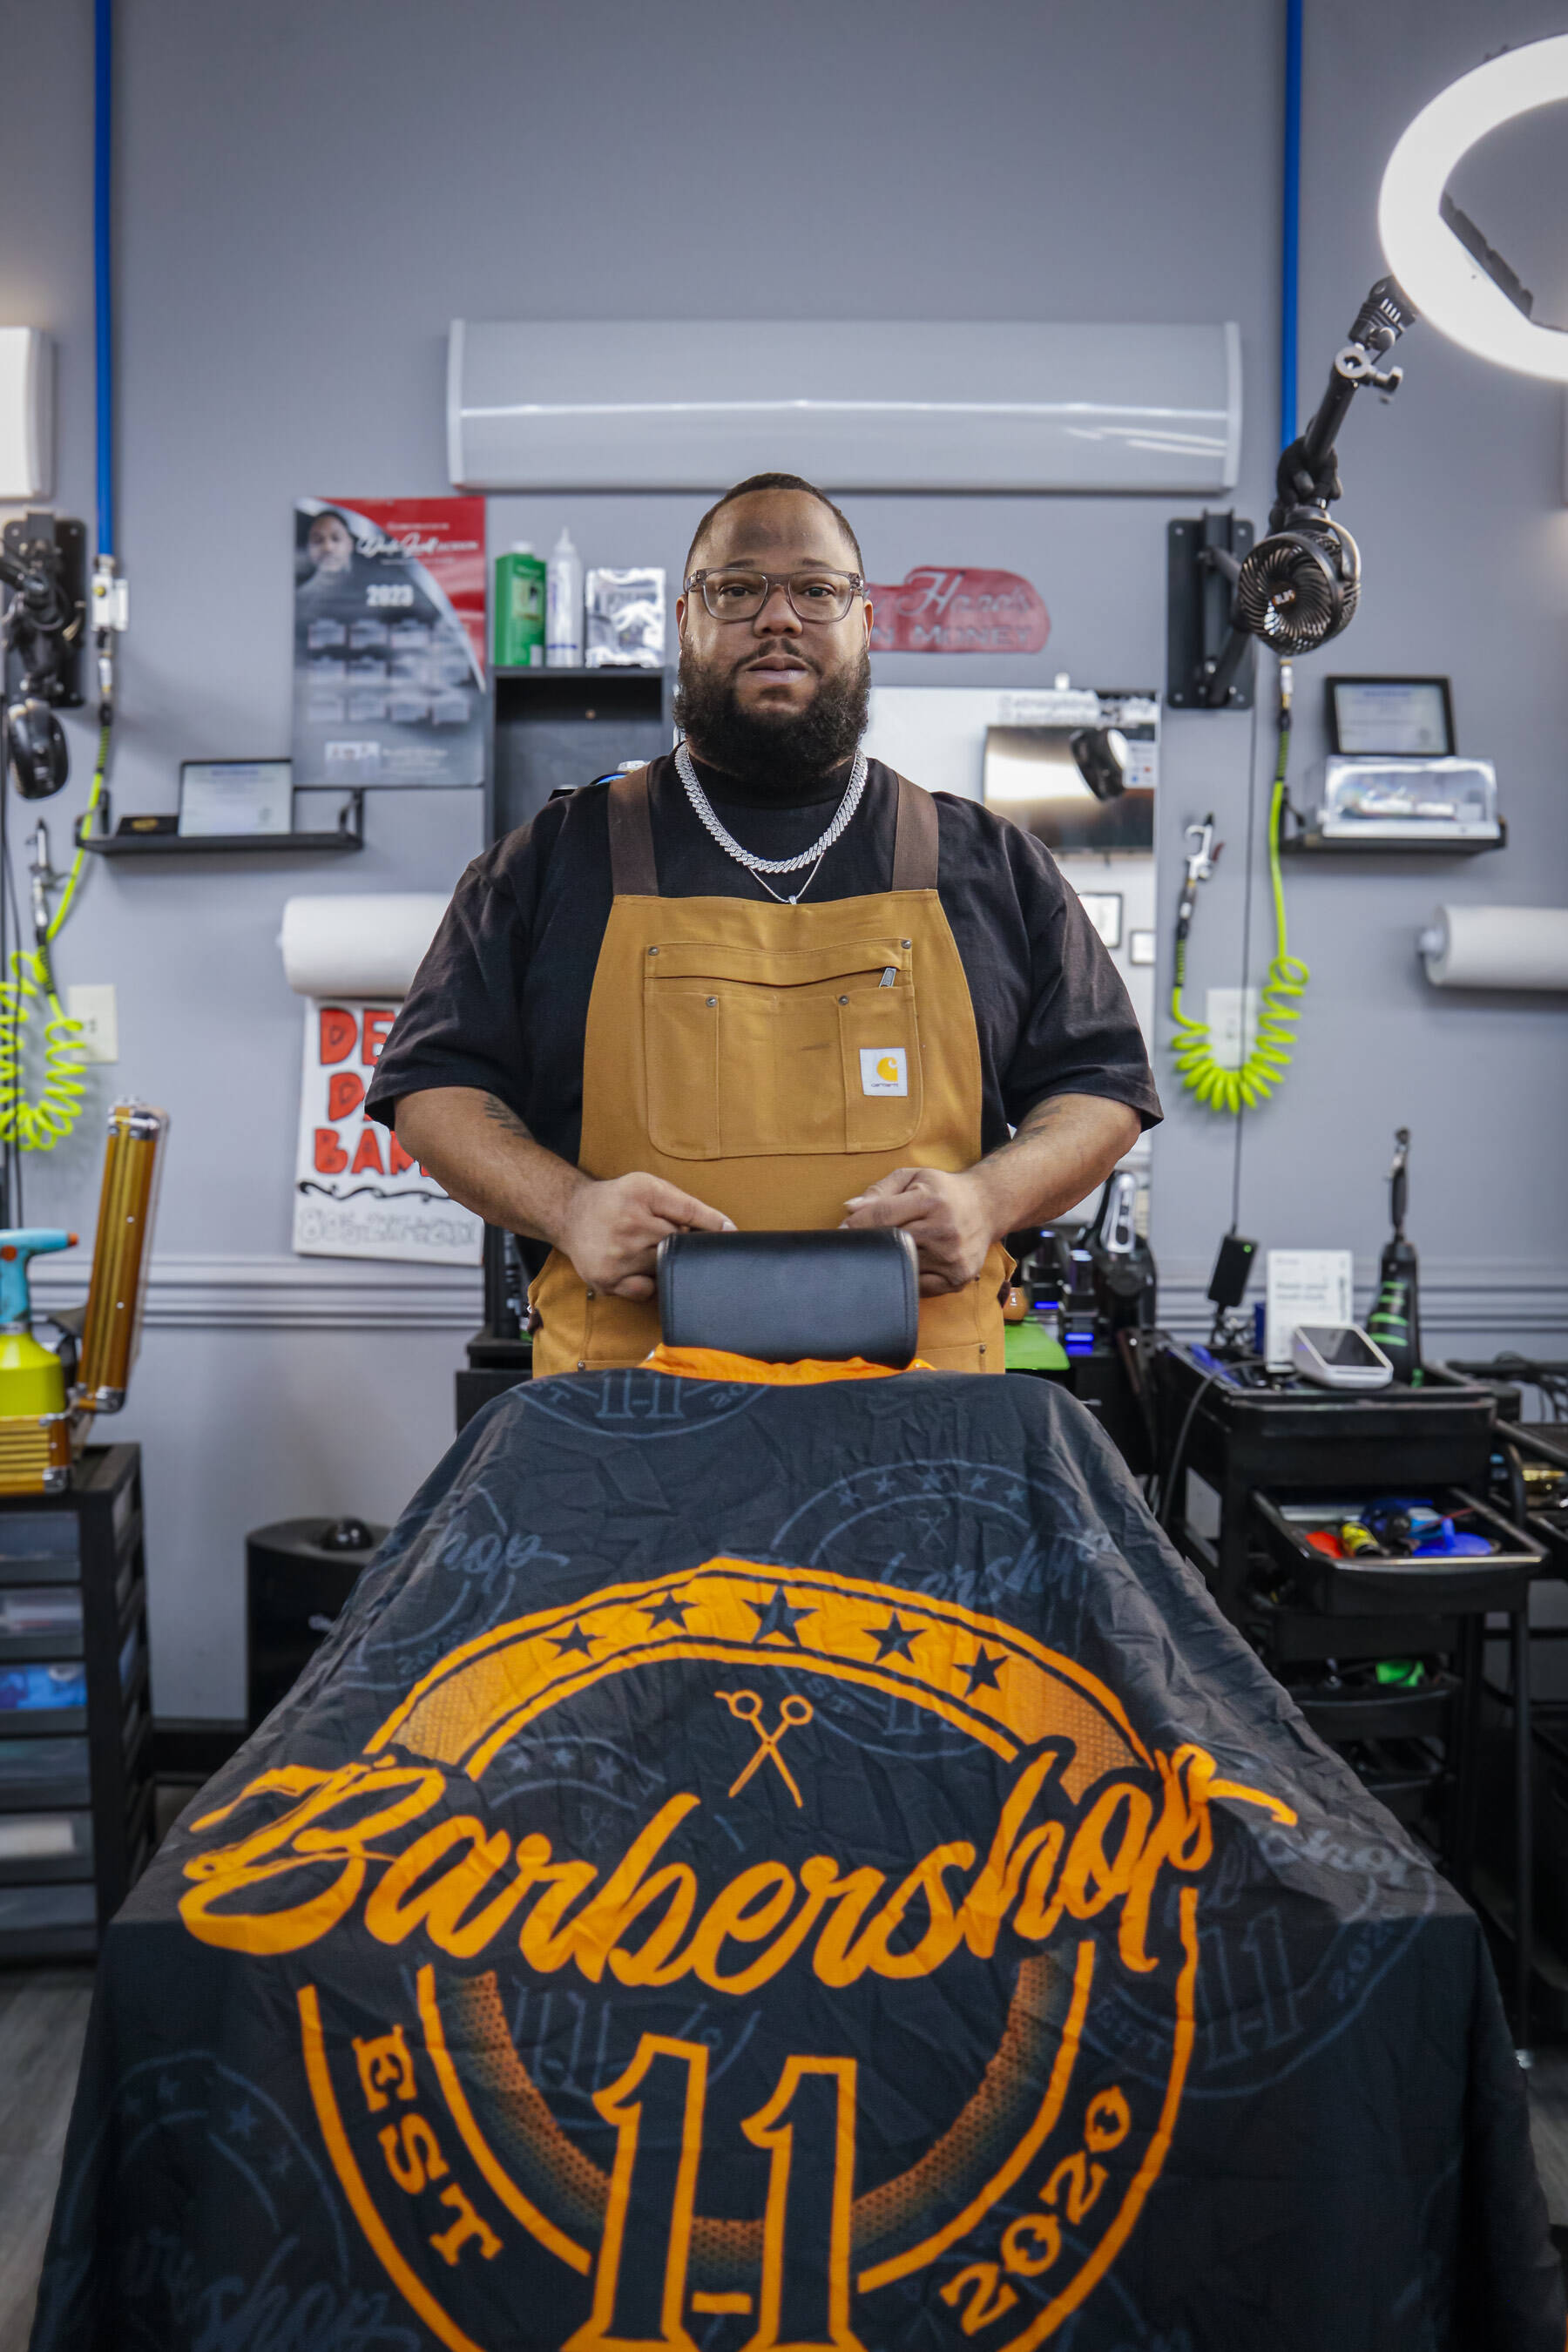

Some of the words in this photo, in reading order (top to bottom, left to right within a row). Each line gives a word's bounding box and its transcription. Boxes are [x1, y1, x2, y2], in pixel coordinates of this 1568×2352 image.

[909, 625, 1032, 646] MONEY
[320, 1008, 396, 1065] DE
[178, 1743, 1298, 1996] Barbershop
[351, 2023, 504, 2266] EST
[558, 2031, 869, 2352] 1-1
[939, 2085, 1132, 2336] 2020
